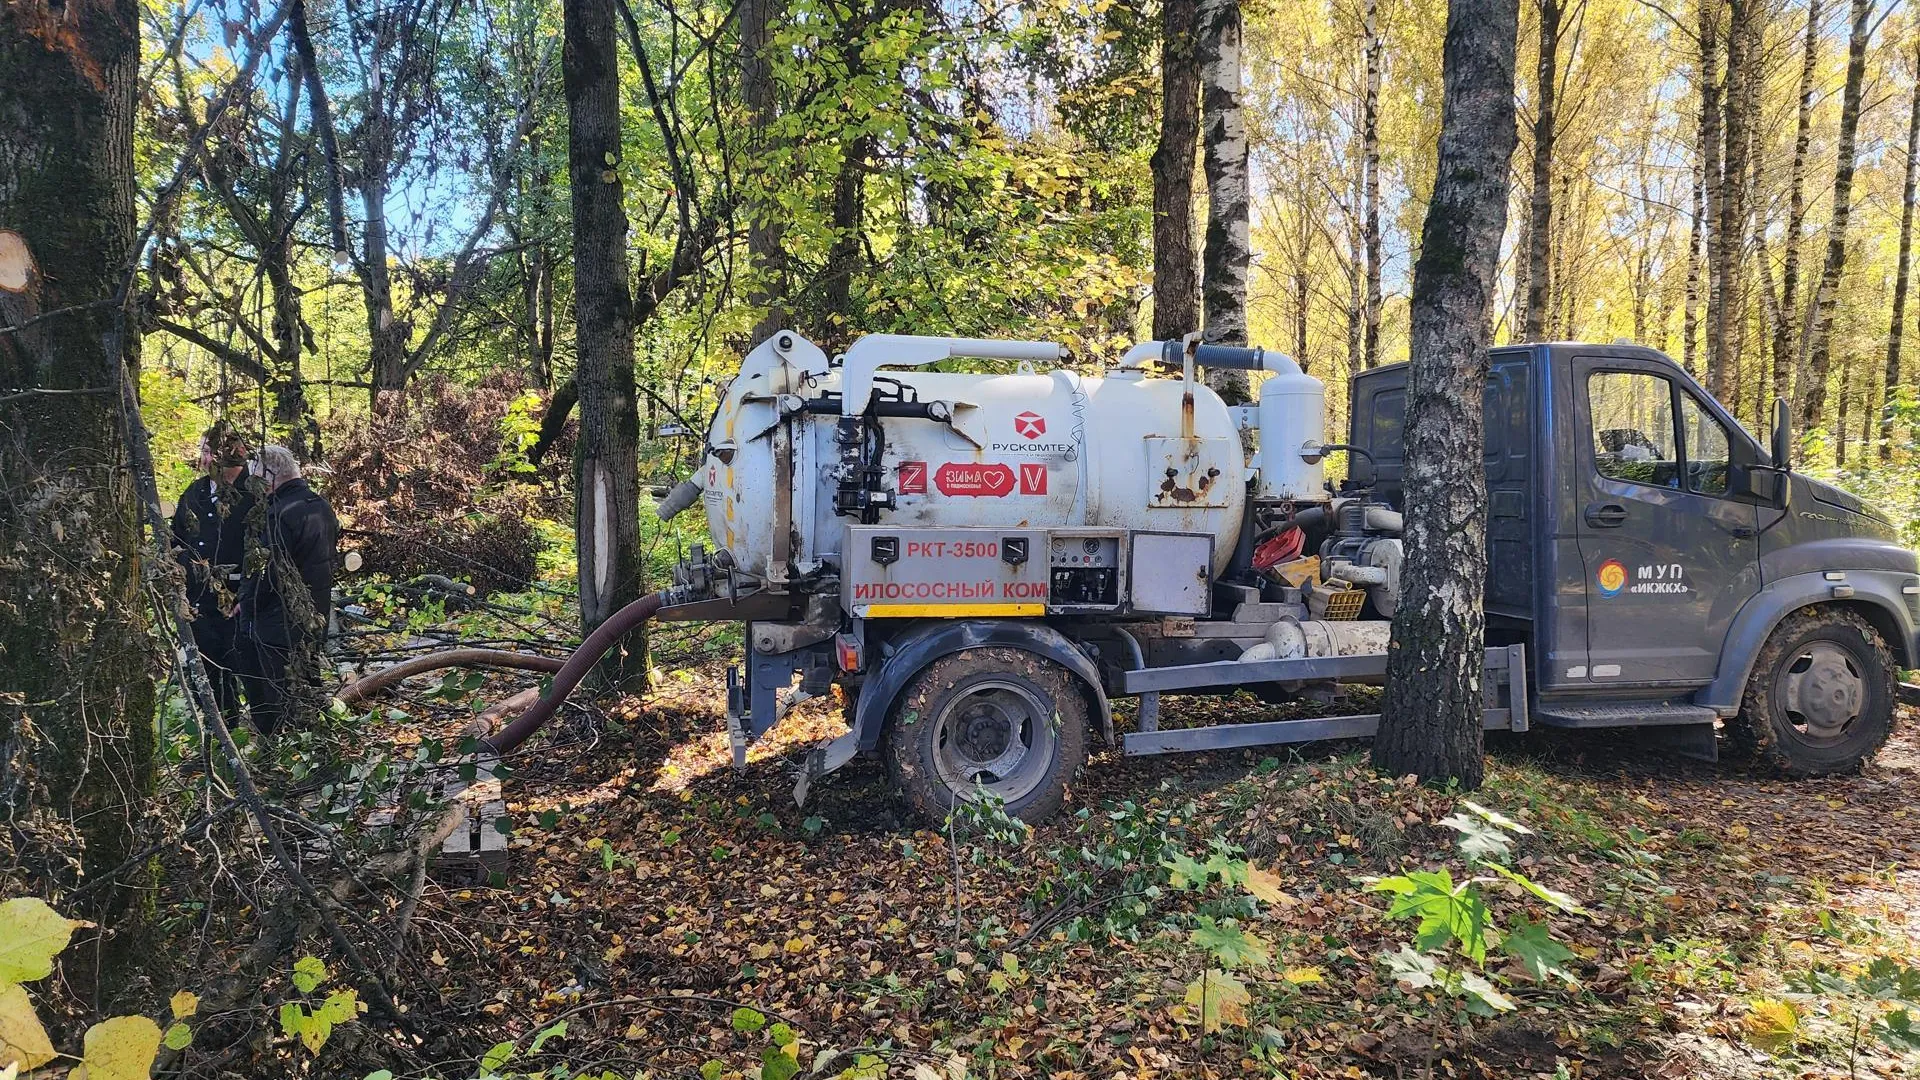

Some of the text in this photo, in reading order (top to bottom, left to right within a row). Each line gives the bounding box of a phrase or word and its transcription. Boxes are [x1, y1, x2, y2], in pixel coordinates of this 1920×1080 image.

[992, 443, 1076, 452] РУСКОМТЕХ
[902, 464, 923, 490] Z
[948, 470, 982, 483] ЗИМА
[1023, 466, 1044, 492] V
[907, 542, 998, 558] РКТ-3500
[1637, 563, 1683, 579] МУП
[855, 580, 1048, 599] ИЛОСОСНЫЙ КОМ
[1630, 582, 1688, 593] «ИКЖКХ»
